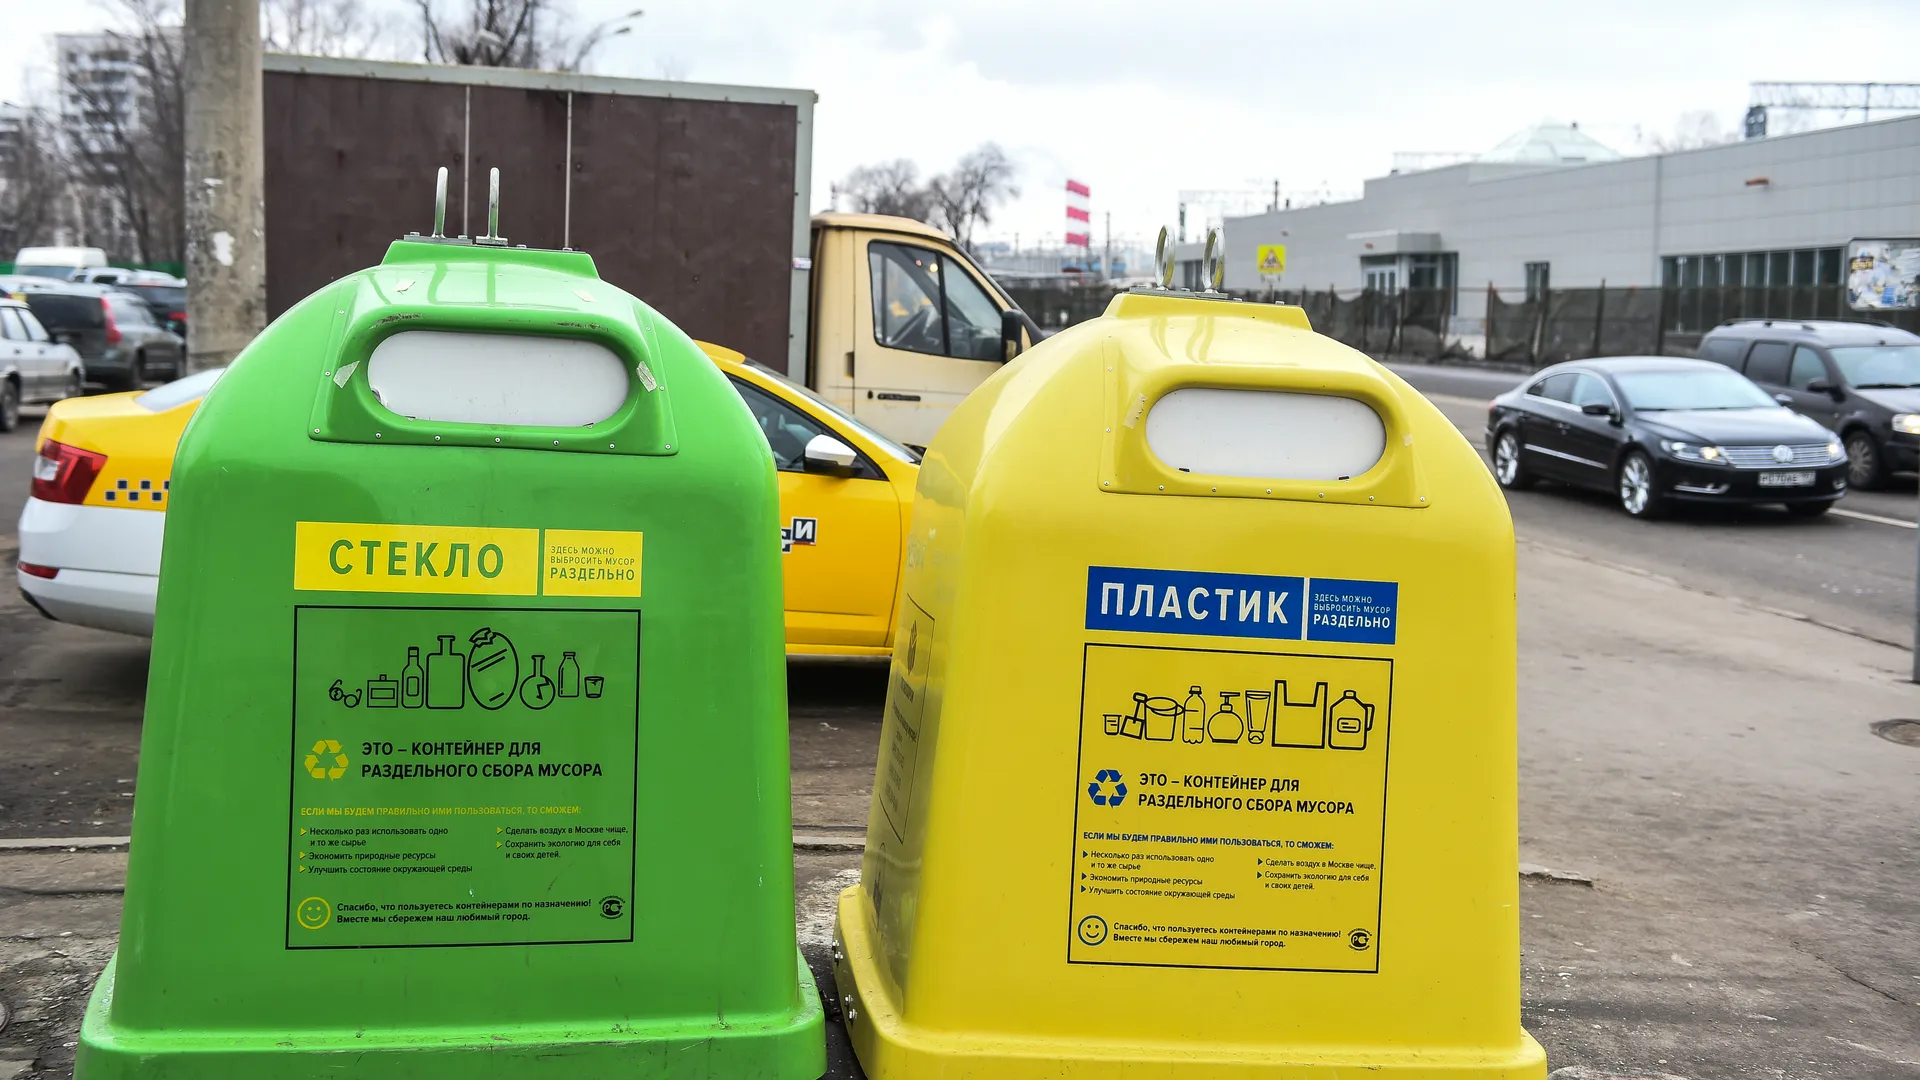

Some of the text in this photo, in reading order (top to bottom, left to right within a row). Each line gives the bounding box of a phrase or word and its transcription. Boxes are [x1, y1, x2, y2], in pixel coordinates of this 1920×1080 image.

[551, 546, 614, 555] ЗДЕСЬ МОЖНО
[329, 539, 503, 578] СТЕКЛО
[550, 556, 635, 566] ВЫБРОСИТЬ МУСОР
[550, 567, 634, 581] РАЗДЕЛЬНО
[1101, 582, 1289, 624] ПЛАСТИК
[1314, 593, 1372, 604] ЗДЕСЬ МОЖНО
[1314, 603, 1391, 614] ВЫБРОСИТЬ МУСОР
[1314, 614, 1390, 628] РАЗДЕЛЬНО
[362, 742, 393, 755] ЭТО
[412, 740, 504, 755] КОНТЕЙНЕР
[508, 742, 540, 757] ДЛЯ
[362, 763, 602, 780] РАЗДЕЛЬНОГО СБОРА МУСОРА
[1139, 773, 1167, 786] ЭТО
[1184, 774, 1267, 790] КОНТЕЙНЕР
[1270, 779, 1299, 793] ДЛЯ
[1139, 794, 1354, 814] РАЗДЕЛЬНОГО СБОРА МУСОРА
[344, 808, 374, 816] БУДЕМ
[376, 807, 430, 815] ПРАВИЛЬНО
[432, 807, 452, 815] ИМИ
[527, 806, 538, 814] ТО
[540, 806, 581, 814] СМОЖЕМ:
[310, 827, 354, 835] Несколько
[428, 828, 448, 836] одно
[505, 827, 538, 836] Сделать
[539, 828, 566, 836] воздух
[505, 840, 546, 849] Сохранить
[586, 840, 601, 848] для
[1083, 832, 1104, 840] ЕСЛИ
[1122, 833, 1148, 842] БУДЕМ
[1150, 835, 1198, 844] ПРАВИЛЬНО
[1200, 837, 1218, 845] ИМИ
[1220, 838, 1283, 848] ПОЛЬЗОВАТЬСЯ,
[1285, 840, 1295, 848] ТО
[1296, 841, 1334, 849] СМОЖЕМ:
[309, 852, 436, 861] Экономить природные ресурсы
[536, 851, 561, 859] детей.
[1091, 851, 1130, 859] Несколько
[1146, 854, 1195, 862] использовать
[1118, 863, 1141, 871] сырье
[1265, 858, 1294, 867] Сделать
[1296, 861, 1320, 869] воздух
[1328, 860, 1354, 868] Москве
[308, 865, 348, 875] Улучшить
[393, 865, 445, 874] окружающей
[447, 866, 472, 874] среды
[1265, 870, 1302, 880] Сохранить
[1090, 873, 1129, 882] Экономить
[1173, 878, 1203, 886] ресурсы
[1089, 886, 1124, 896] Улучшить
[1164, 891, 1211, 899] окружающей
[1212, 892, 1235, 900] среды
[337, 903, 378, 911] Спасибо,
[398, 904, 454, 912] пользуетесь
[456, 902, 519, 910] контейнерами
[535, 899, 591, 908] назначению!
[337, 915, 369, 923] Вместе
[388, 914, 433, 924] сбережем
[456, 913, 500, 921] любимый
[502, 914, 530, 922] город.
[1114, 922, 1150, 932] Спасибо,
[1167, 926, 1218, 935] пользуетесь
[1219, 928, 1276, 936] контейнерами
[1290, 930, 1341, 938] назначению!
[1113, 933, 1142, 942] Вместе
[1159, 936, 1199, 945] сбережем
[1220, 938, 1259, 946] любимый
[1261, 940, 1286, 948] город.
